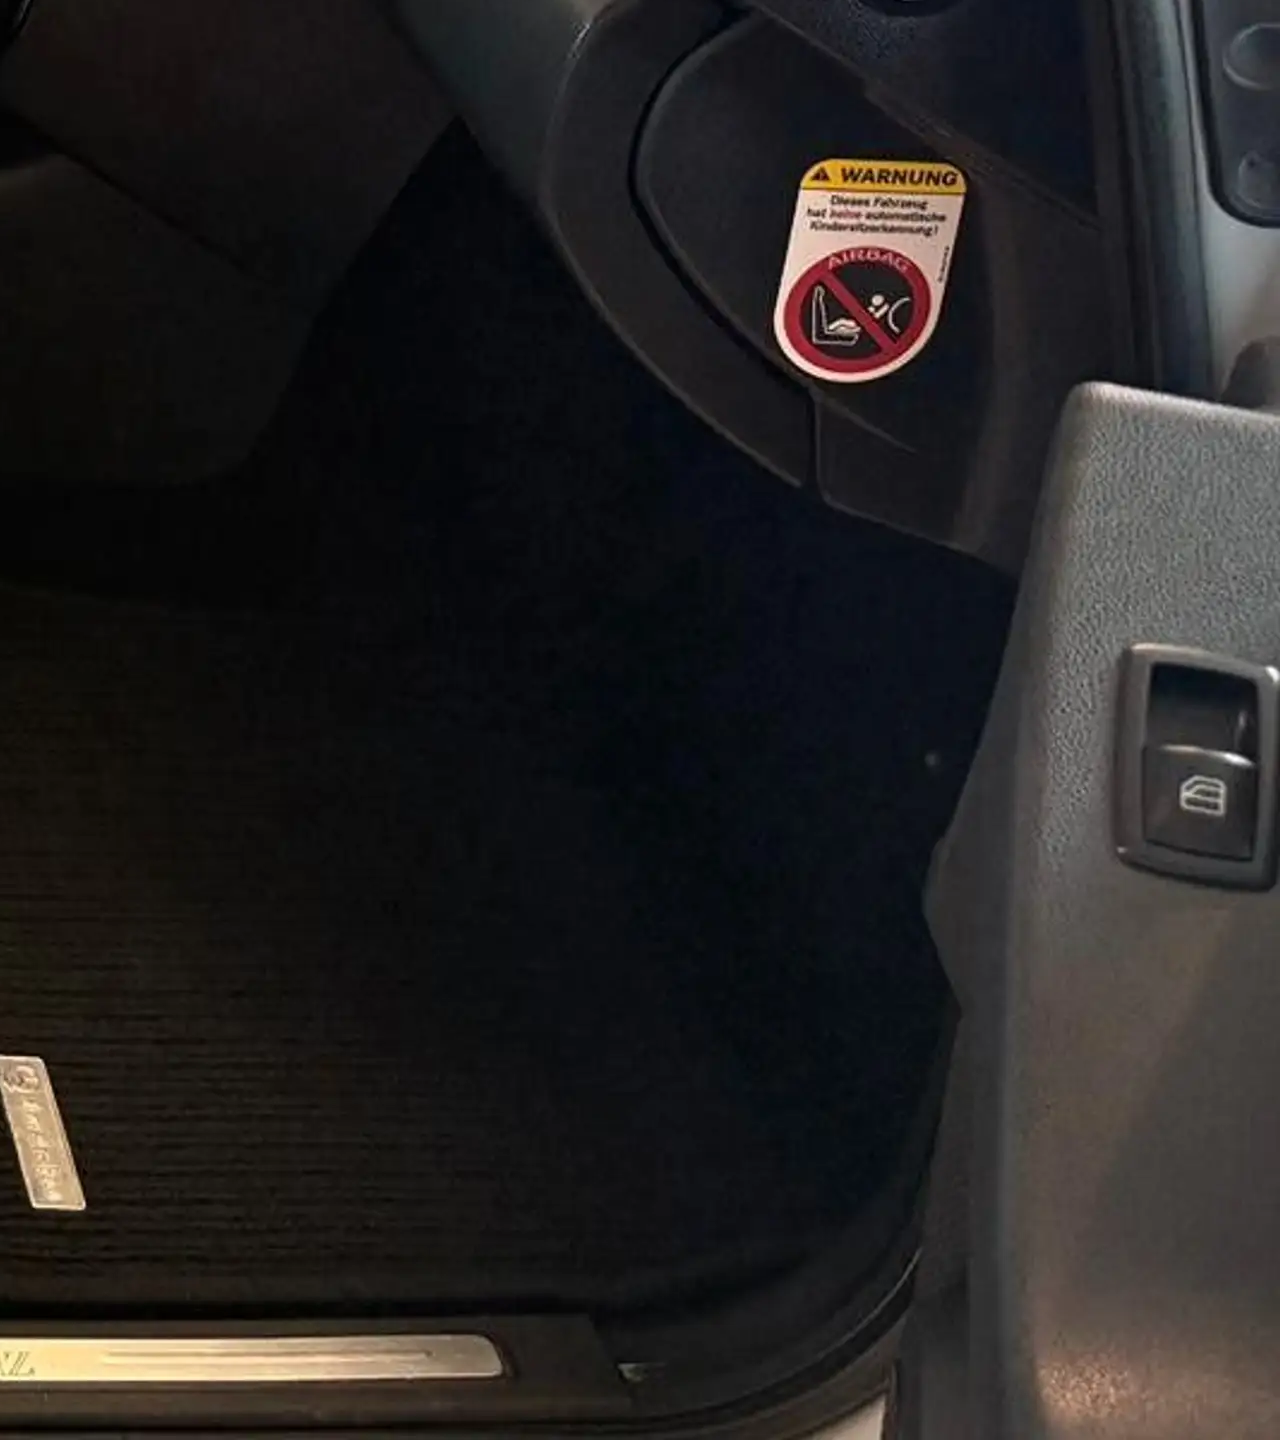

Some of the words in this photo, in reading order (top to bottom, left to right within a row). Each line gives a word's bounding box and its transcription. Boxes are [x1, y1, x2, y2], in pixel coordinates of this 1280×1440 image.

[840, 167, 958, 186] WARNUNG
[830, 194, 871, 207] Dieses
[873, 196, 928, 211] Fahrzeug
[807, 207, 827, 219] hat
[865, 209, 946, 223] automatische
[828, 249, 908, 272] AIRBAG
